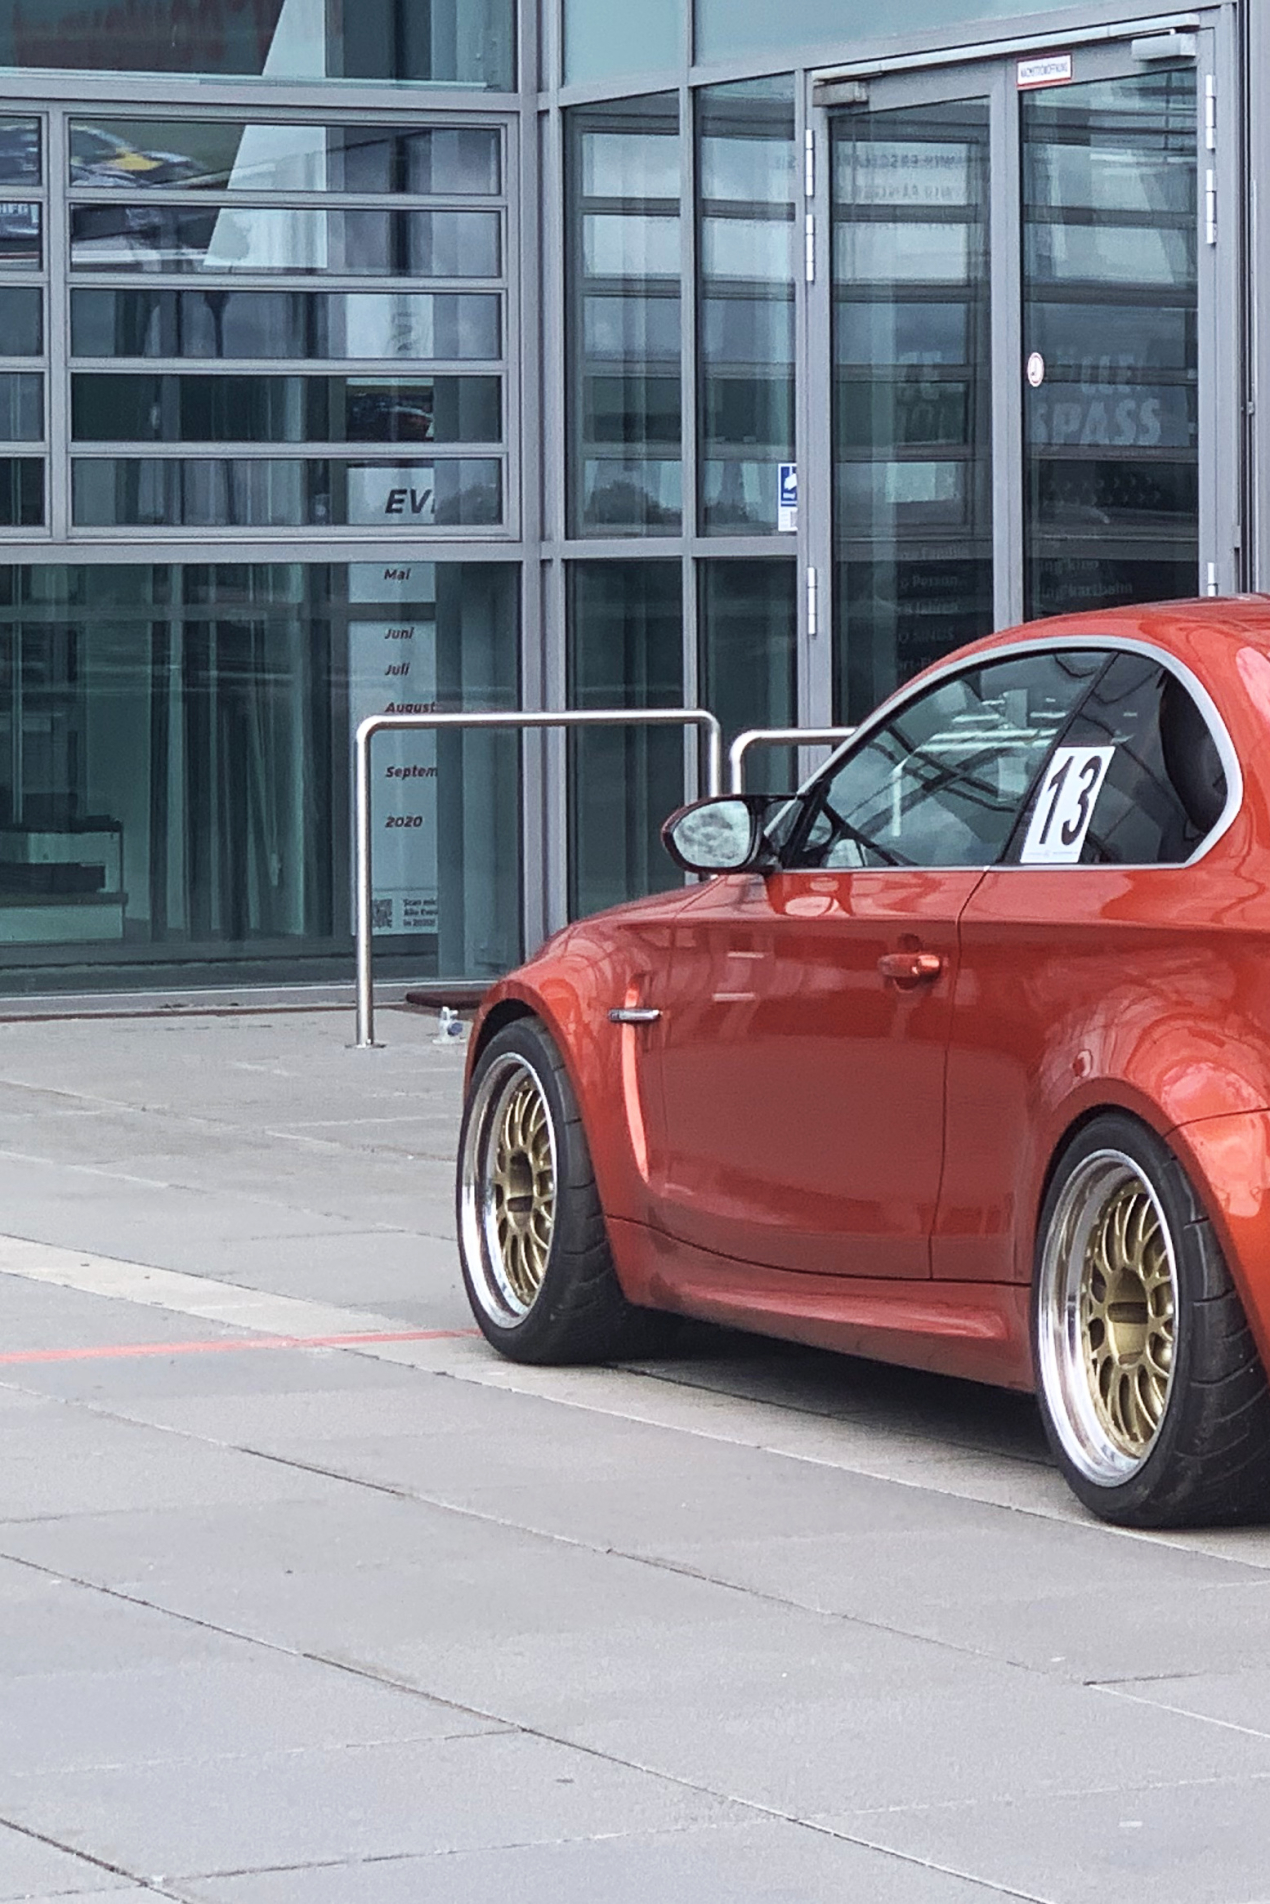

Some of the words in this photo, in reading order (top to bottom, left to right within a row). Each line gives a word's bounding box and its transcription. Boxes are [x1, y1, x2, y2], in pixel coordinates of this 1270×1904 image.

[384, 489, 435, 514] EV
[384, 568, 411, 580] Mai
[384, 627, 415, 641] Juni
[384, 662, 411, 677] Juli
[384, 701, 436, 714] August
[1039, 755, 1103, 846] 13
[385, 815, 423, 829] 2020
